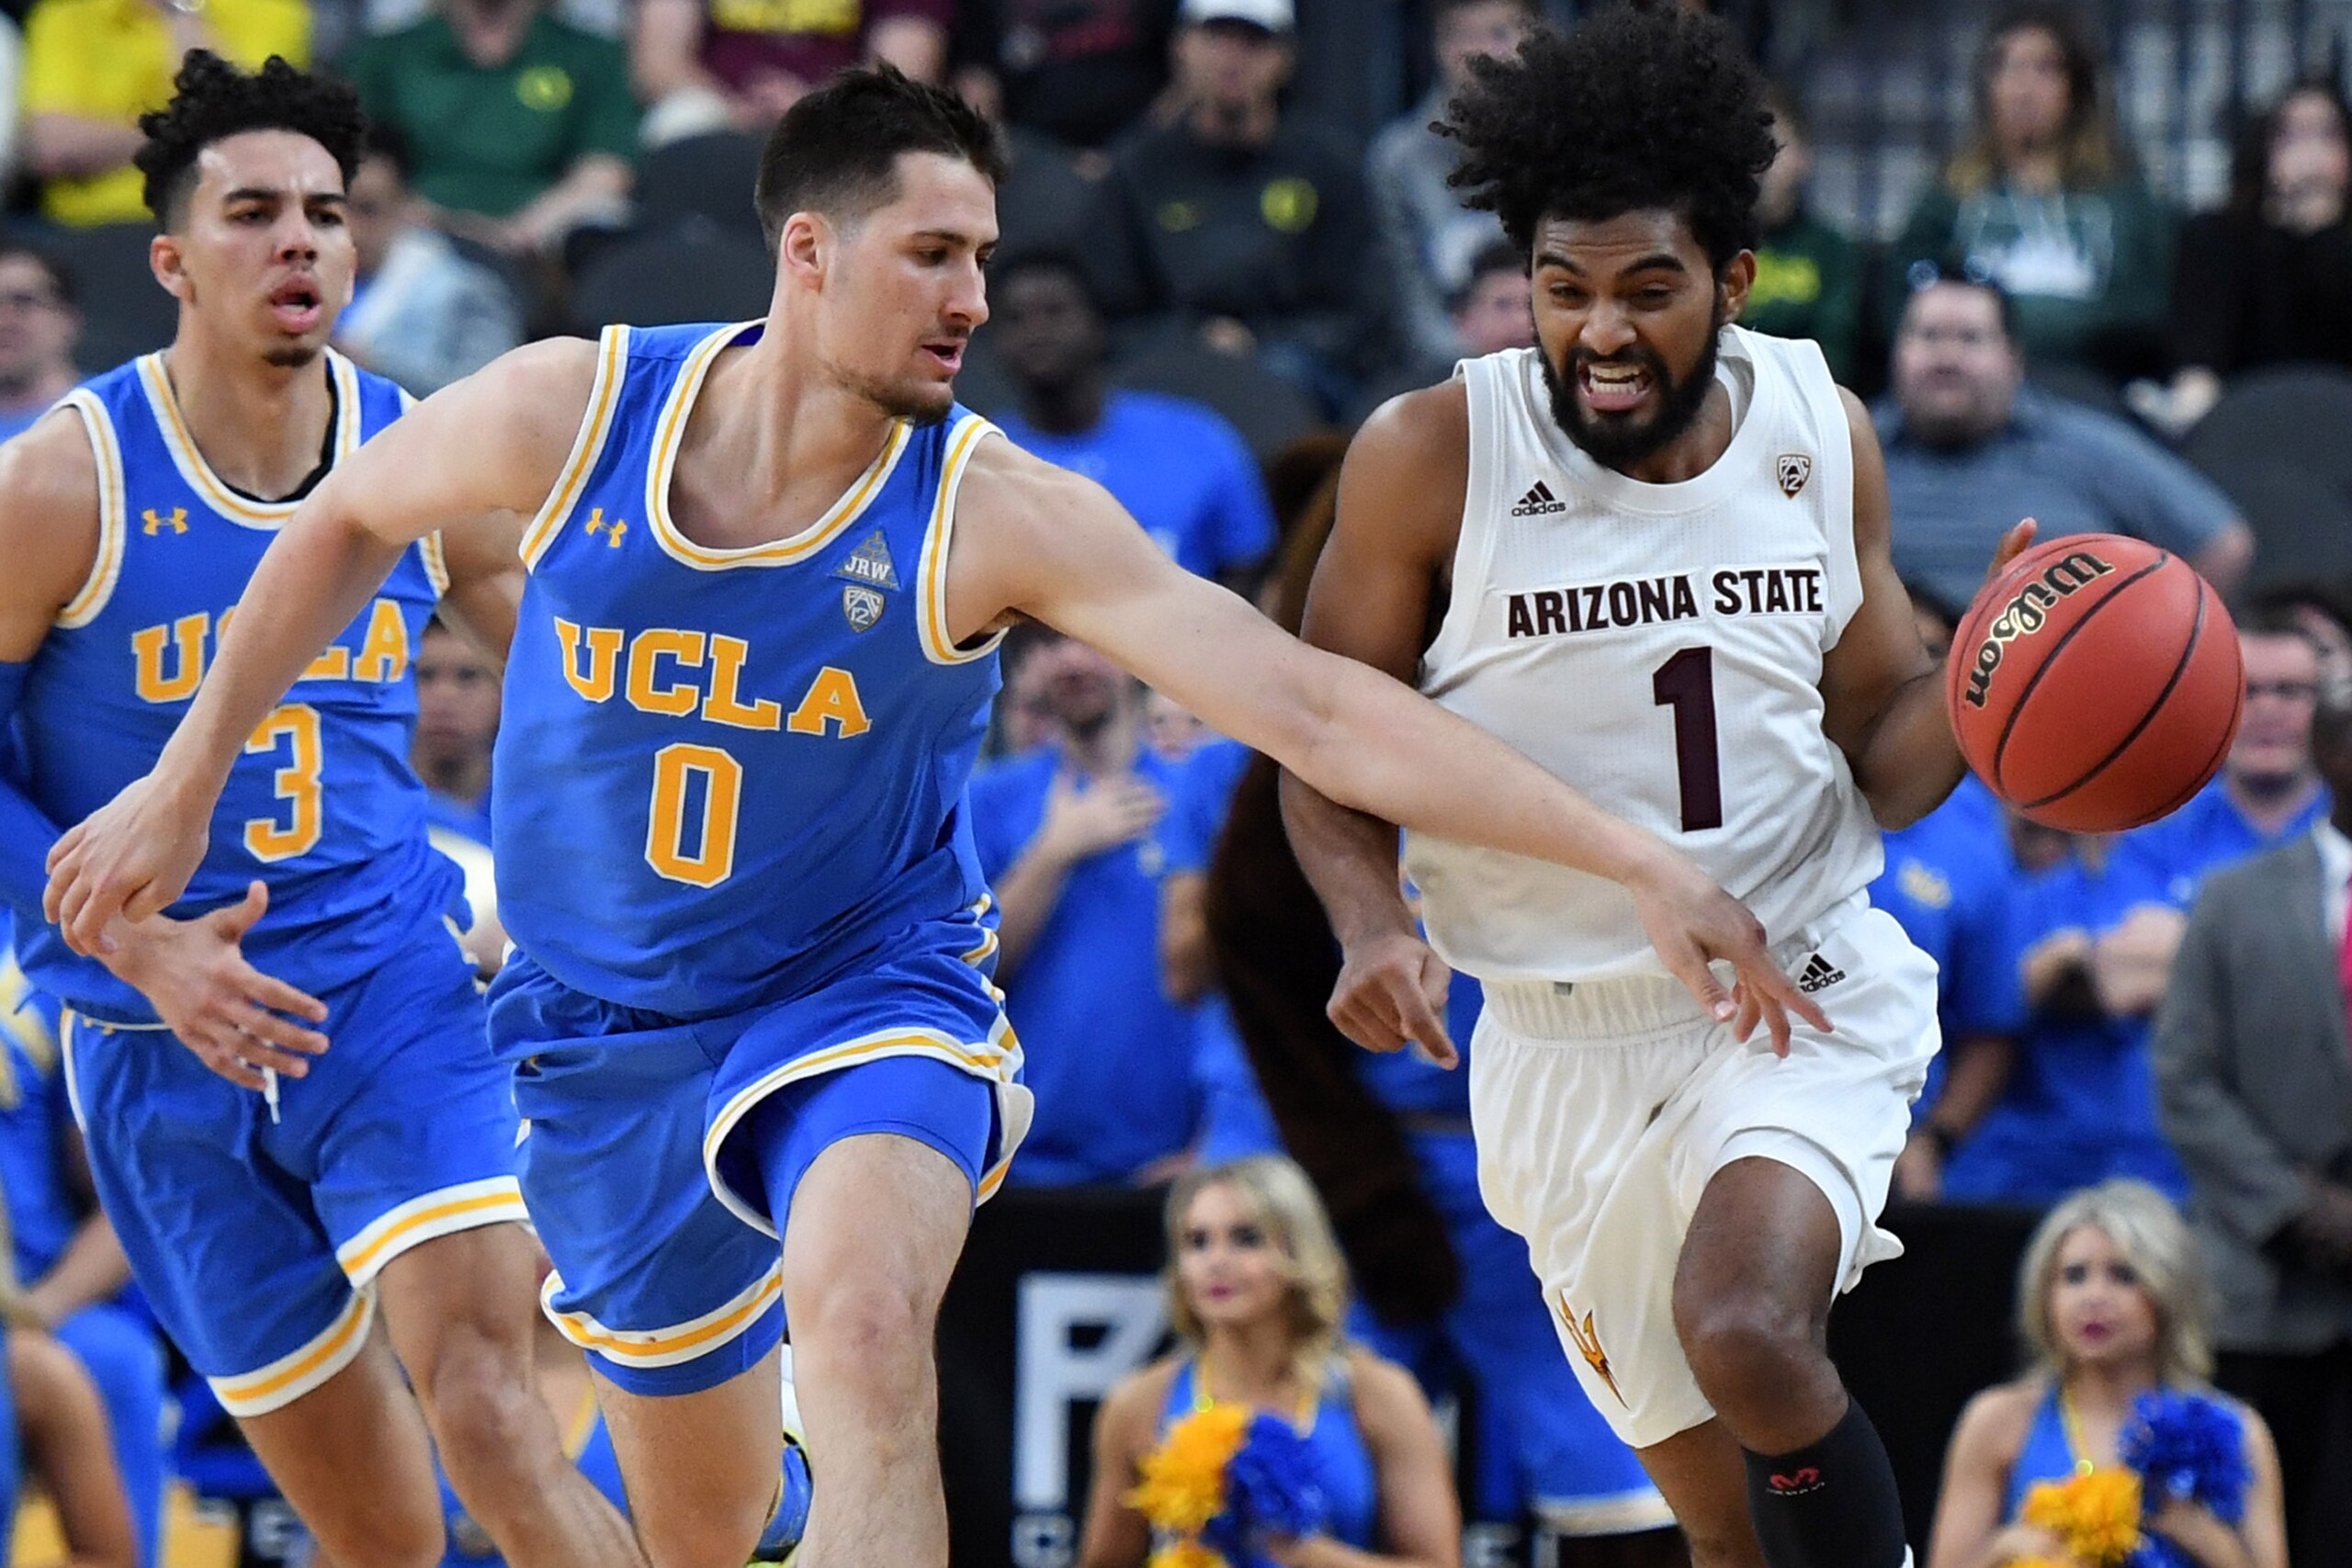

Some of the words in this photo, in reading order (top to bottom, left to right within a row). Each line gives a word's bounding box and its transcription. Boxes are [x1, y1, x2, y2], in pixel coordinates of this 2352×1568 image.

[1779, 456, 1809, 482] PAC
[1783, 474, 1801, 491] 12
[1511, 502, 1566, 517] adidas
[844, 555, 891, 581] JRW
[846, 589, 881, 618] PAC
[850, 606, 870, 625] 12
[1508, 574, 1699, 637] ARIZONA
[1712, 570, 1823, 615] STATE
[1965, 552, 2117, 709] Wilson
[132, 598, 409, 704] UA
[554, 615, 873, 739] UCLA
[1653, 645, 1723, 833] 1
[243, 703, 322, 863] 3
[644, 742, 743, 890] 0
